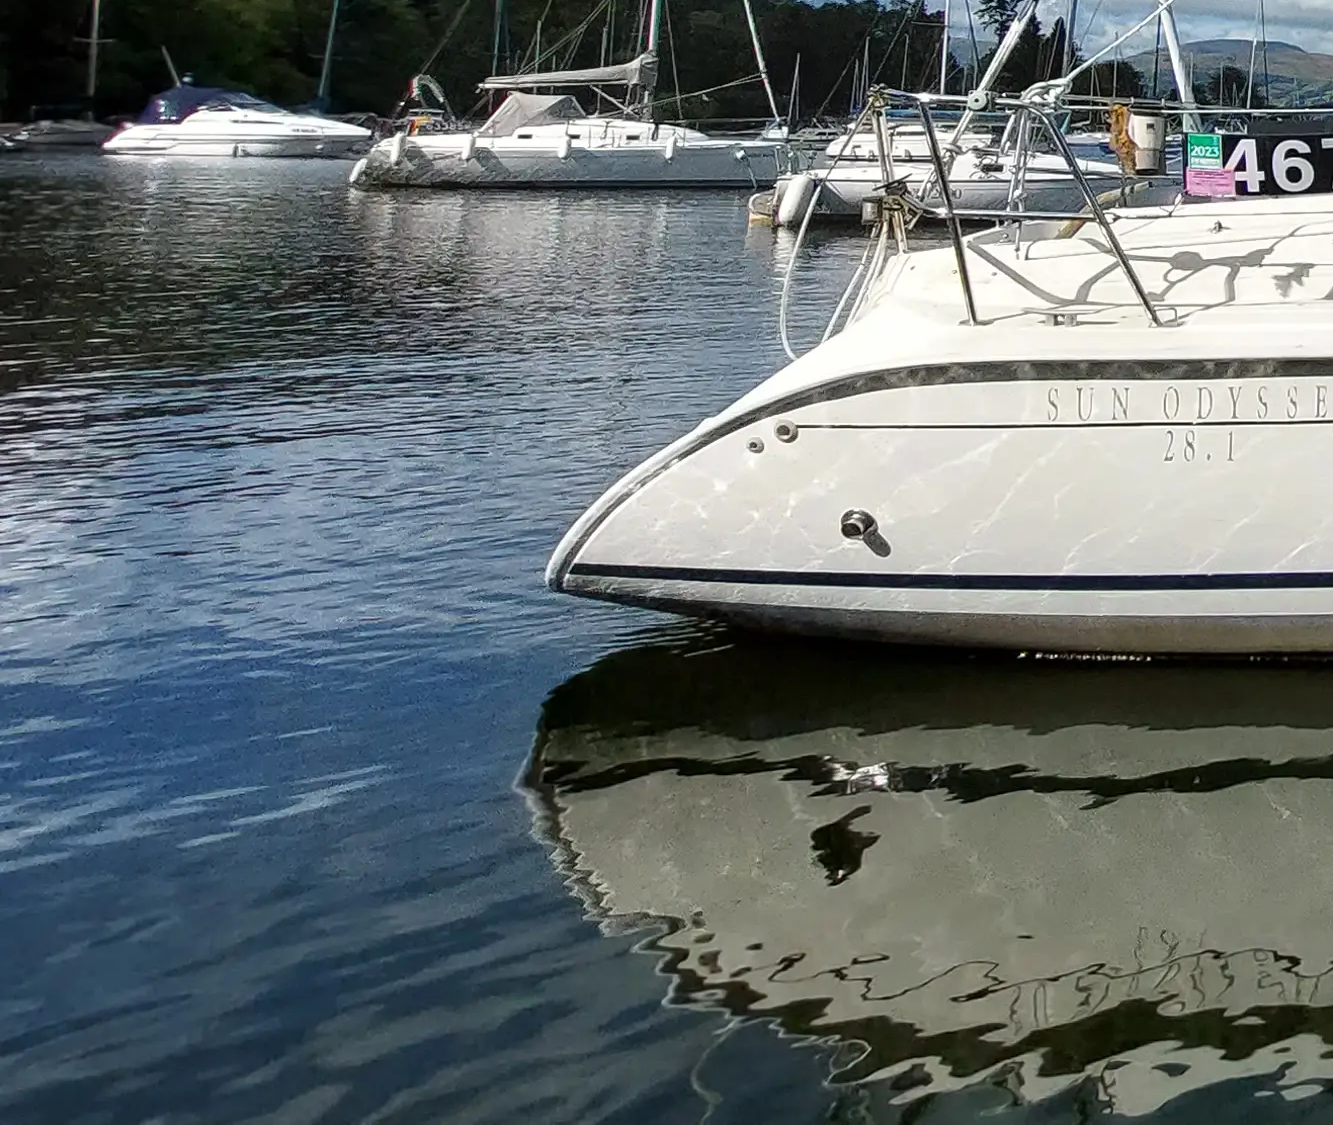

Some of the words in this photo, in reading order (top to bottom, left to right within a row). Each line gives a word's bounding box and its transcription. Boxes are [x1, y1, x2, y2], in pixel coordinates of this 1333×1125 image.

[1191, 145, 1219, 157] 2023
[1047, 387, 1130, 421] SUN
[1163, 430, 1236, 462] 28.1
